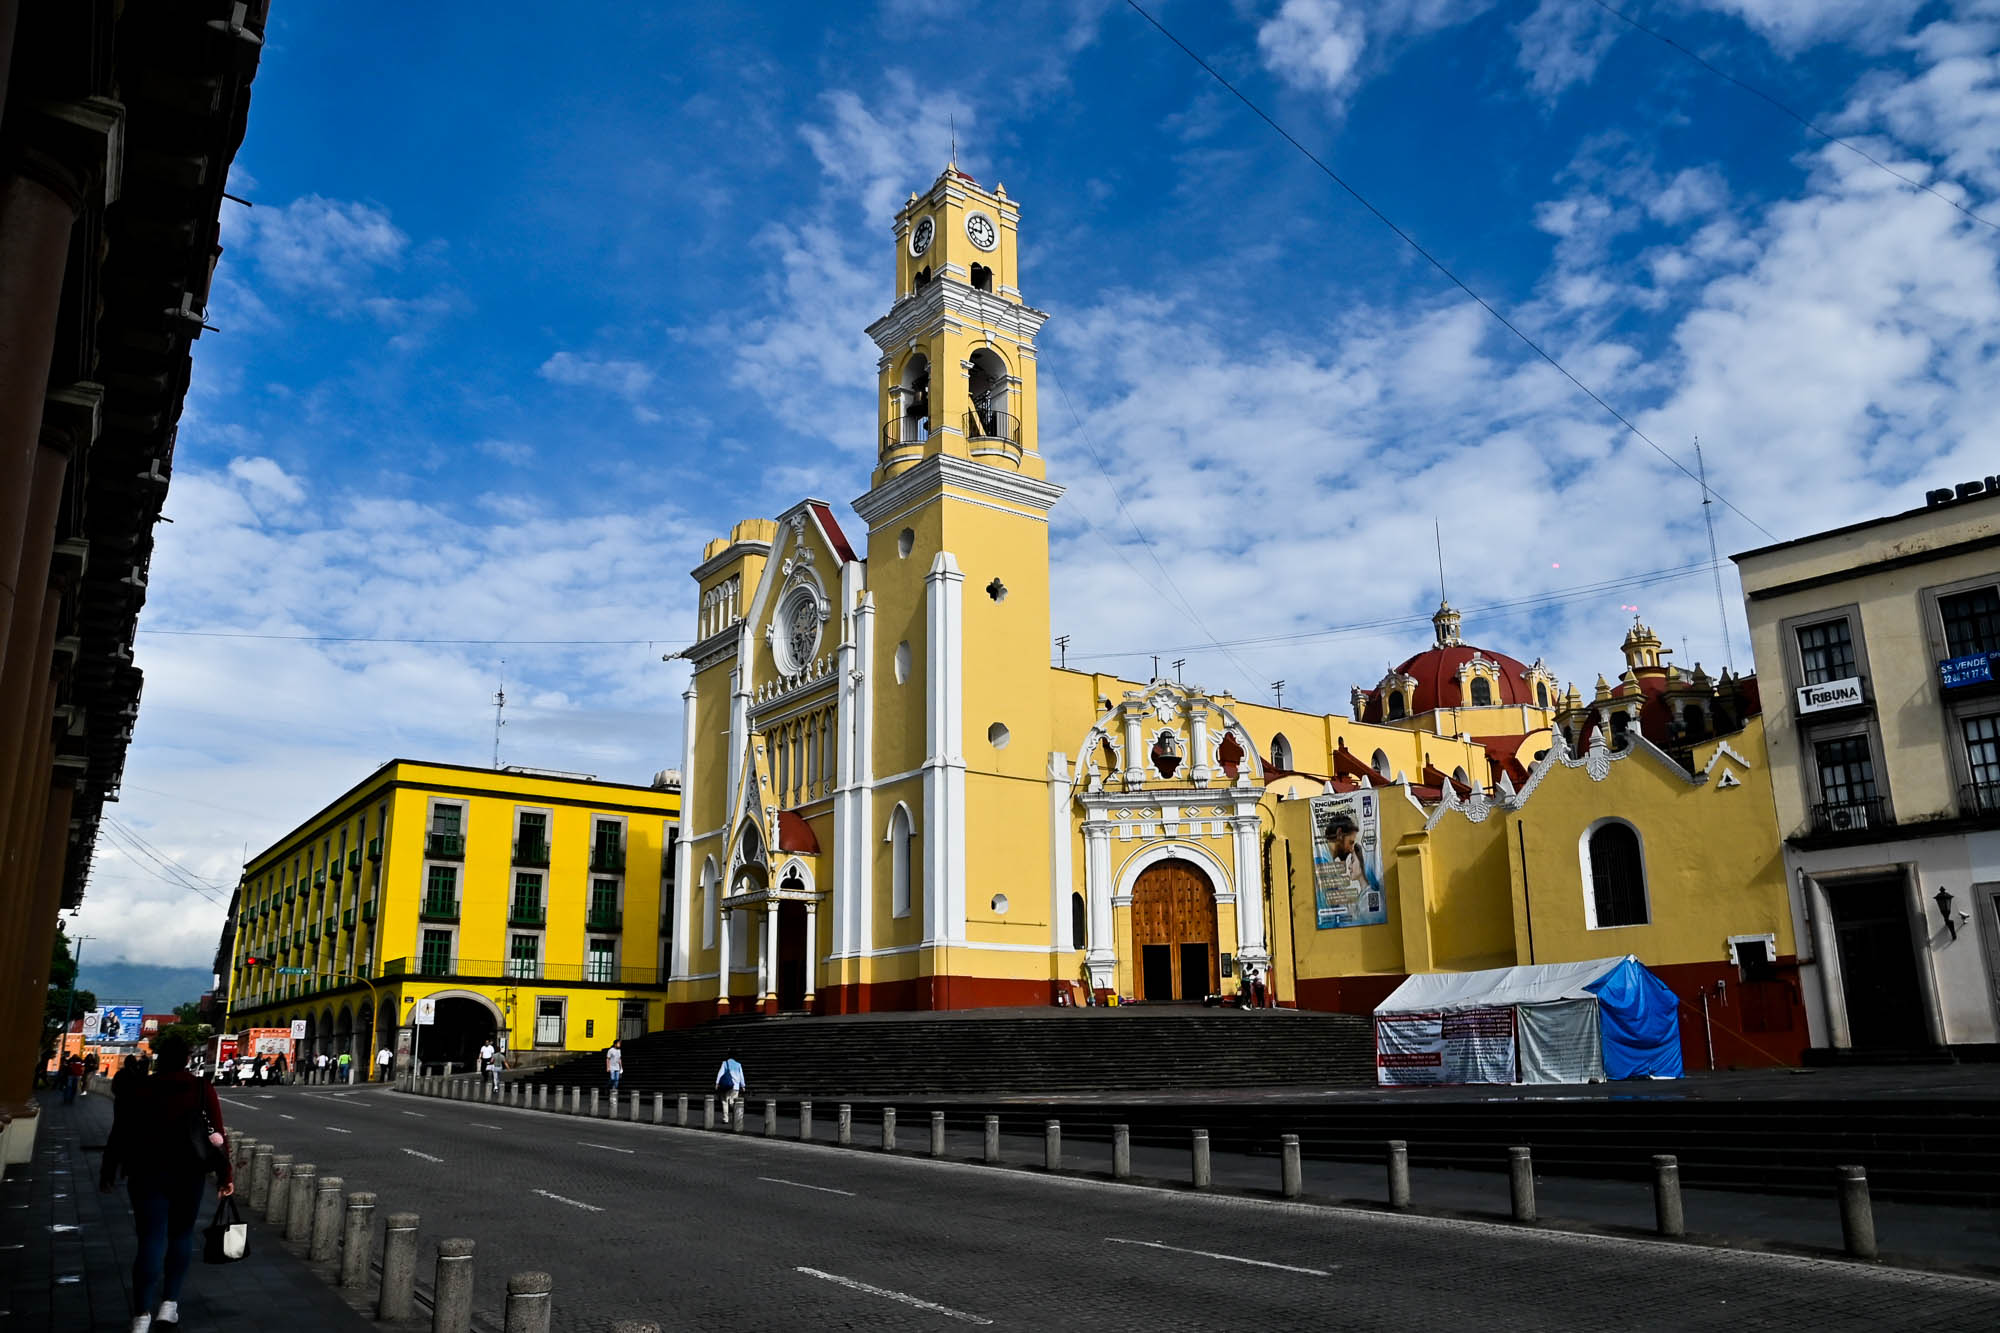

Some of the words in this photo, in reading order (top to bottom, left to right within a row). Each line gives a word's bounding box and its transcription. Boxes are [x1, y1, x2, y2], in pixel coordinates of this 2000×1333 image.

[1955, 657, 1986, 670] VENDE
[1801, 687, 1858, 706] TRIBUNA
[1315, 798, 1353, 807] ENCUENTRO
